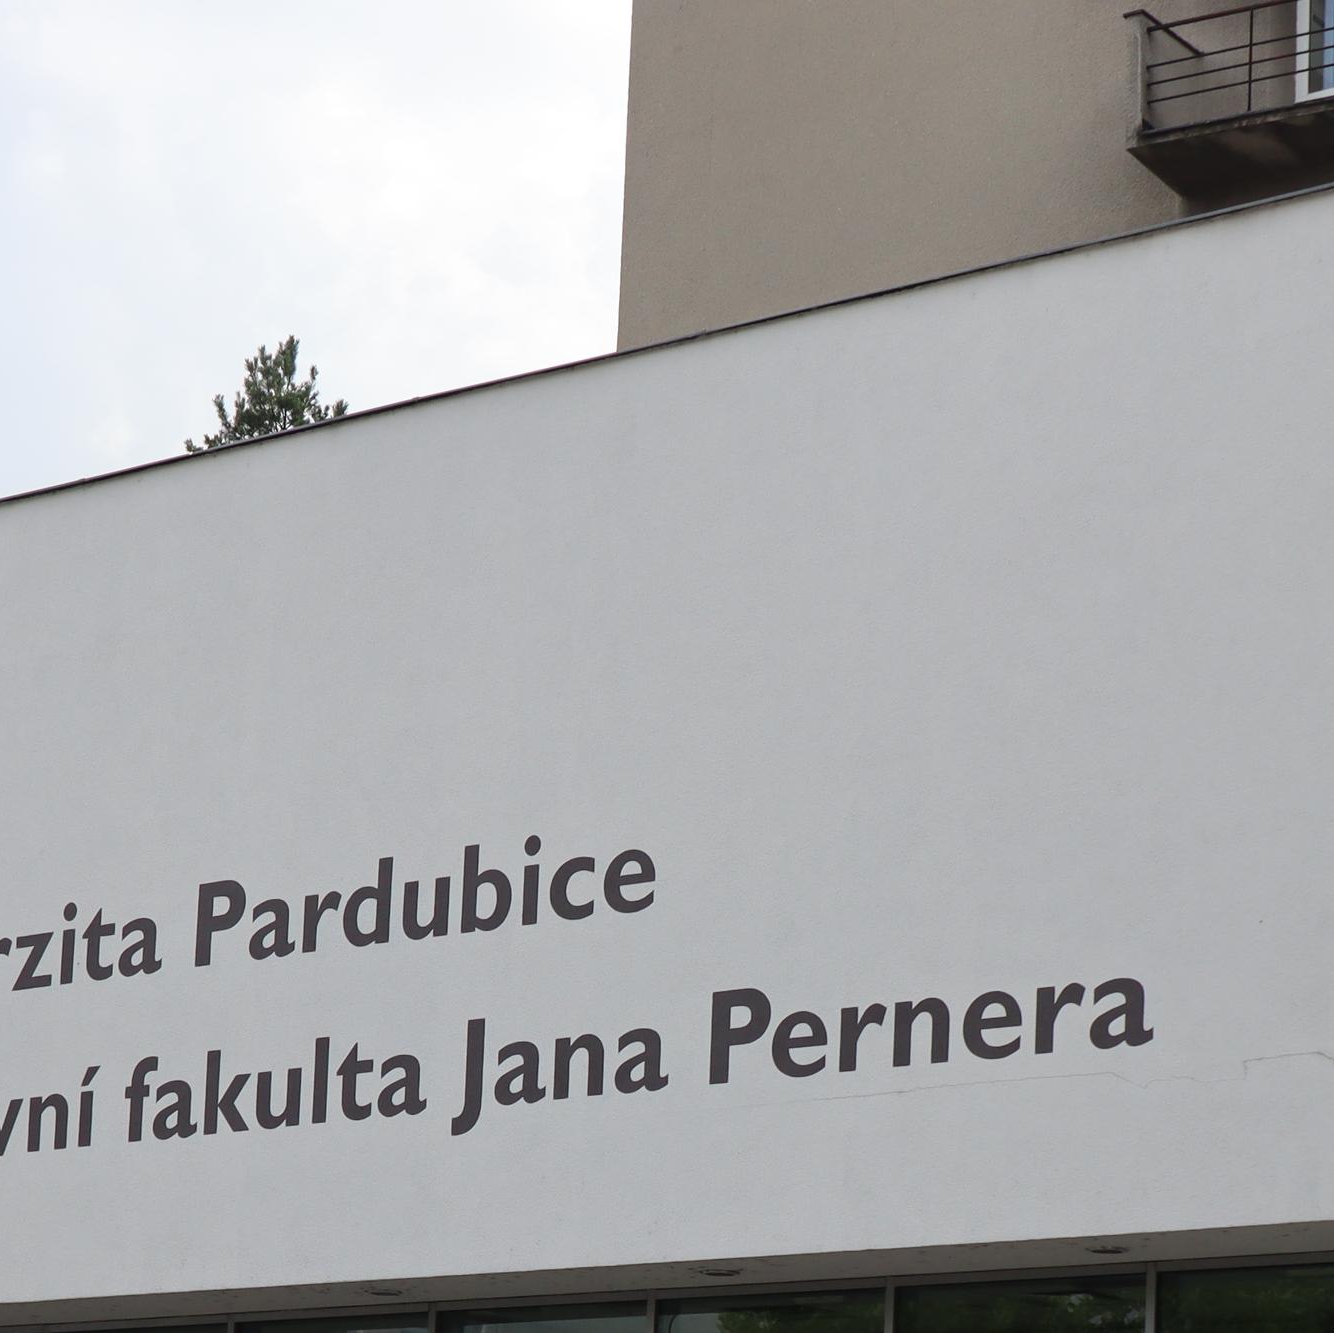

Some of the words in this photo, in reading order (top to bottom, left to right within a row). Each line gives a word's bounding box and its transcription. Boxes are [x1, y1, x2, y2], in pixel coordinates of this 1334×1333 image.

[194, 834, 656, 968] Pardubice
[124, 1036, 428, 1143] fakulta
[450, 1017, 669, 1137] Jana
[708, 977, 1154, 1085] Pernera
